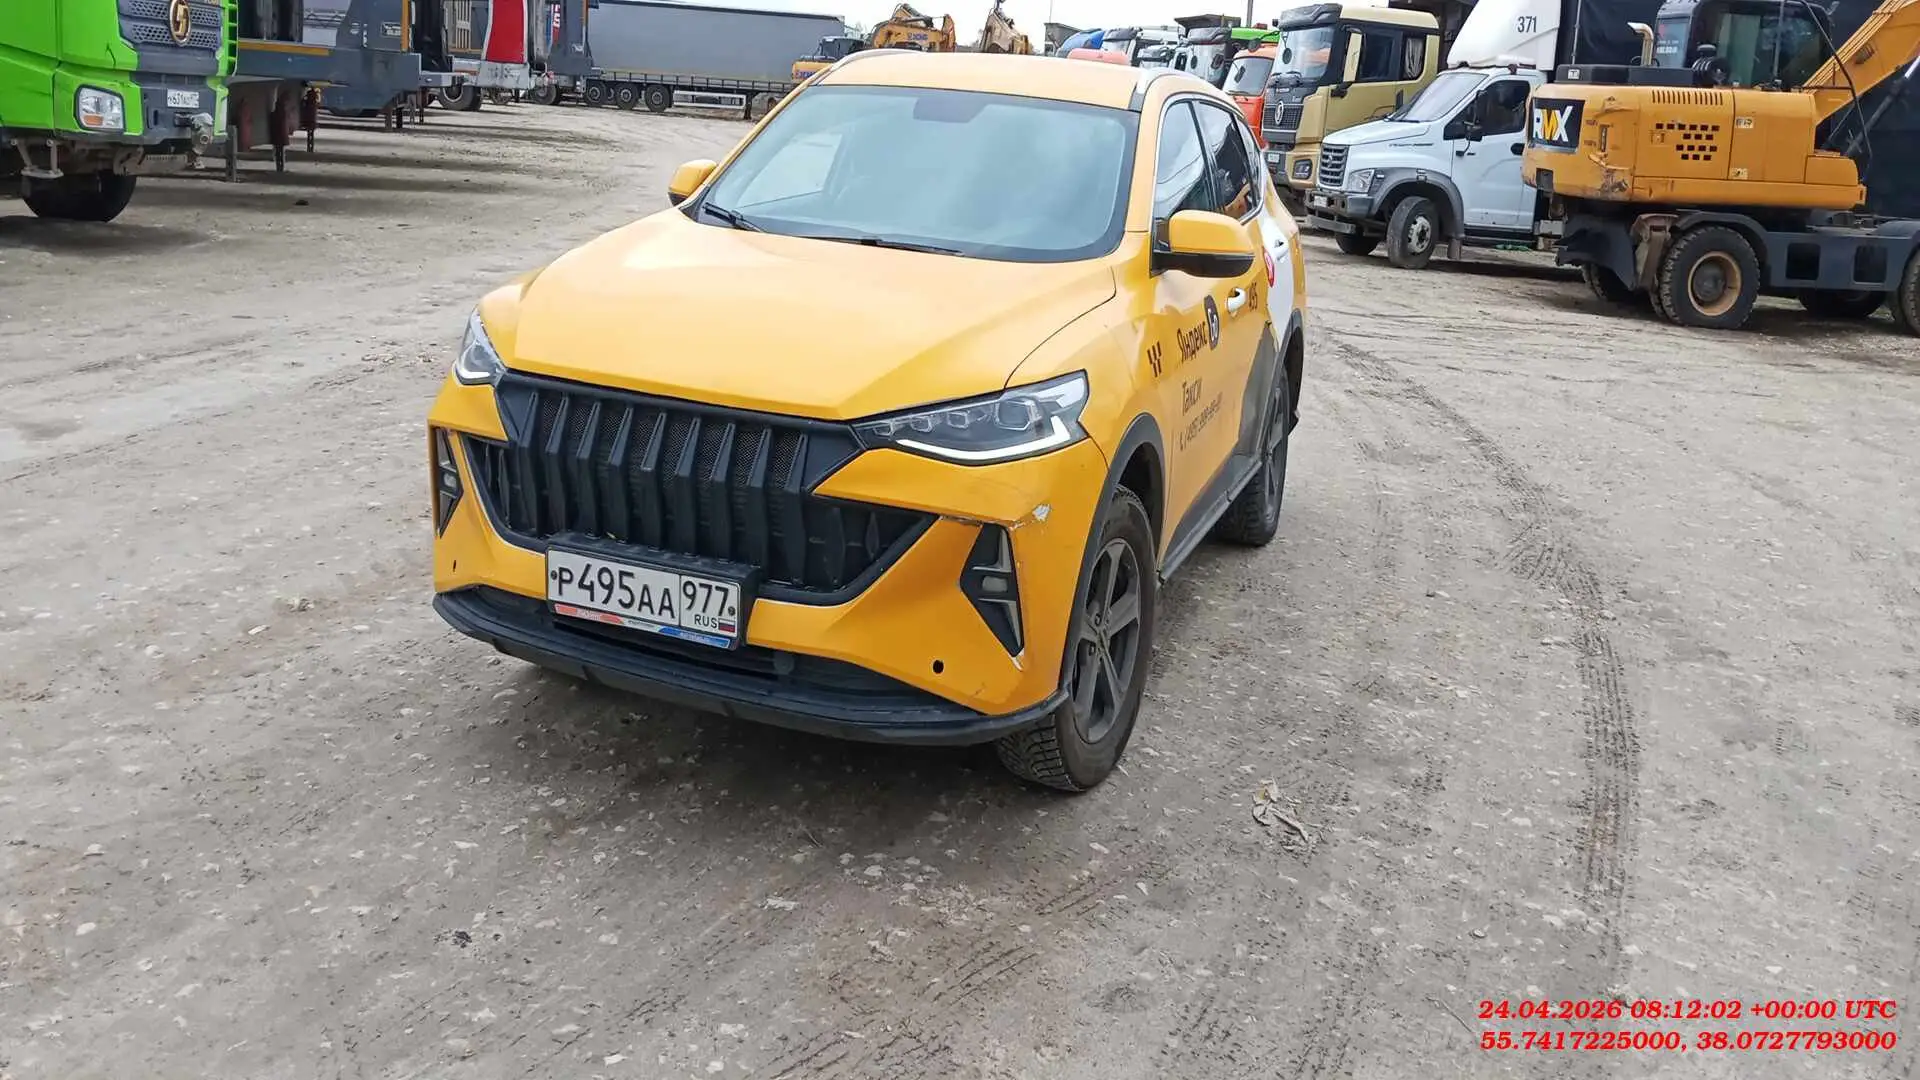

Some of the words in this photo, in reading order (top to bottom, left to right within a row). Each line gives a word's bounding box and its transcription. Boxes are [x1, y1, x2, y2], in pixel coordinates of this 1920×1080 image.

[1517, 15, 1538, 33] 371
[1532, 105, 1573, 143] RMX
[1176, 321, 1208, 363] Яндекс
[1181, 377, 1203, 417] Такси
[557, 563, 676, 619] Р495АА
[682, 580, 730, 617] 977
[694, 614, 718, 630] RUS
